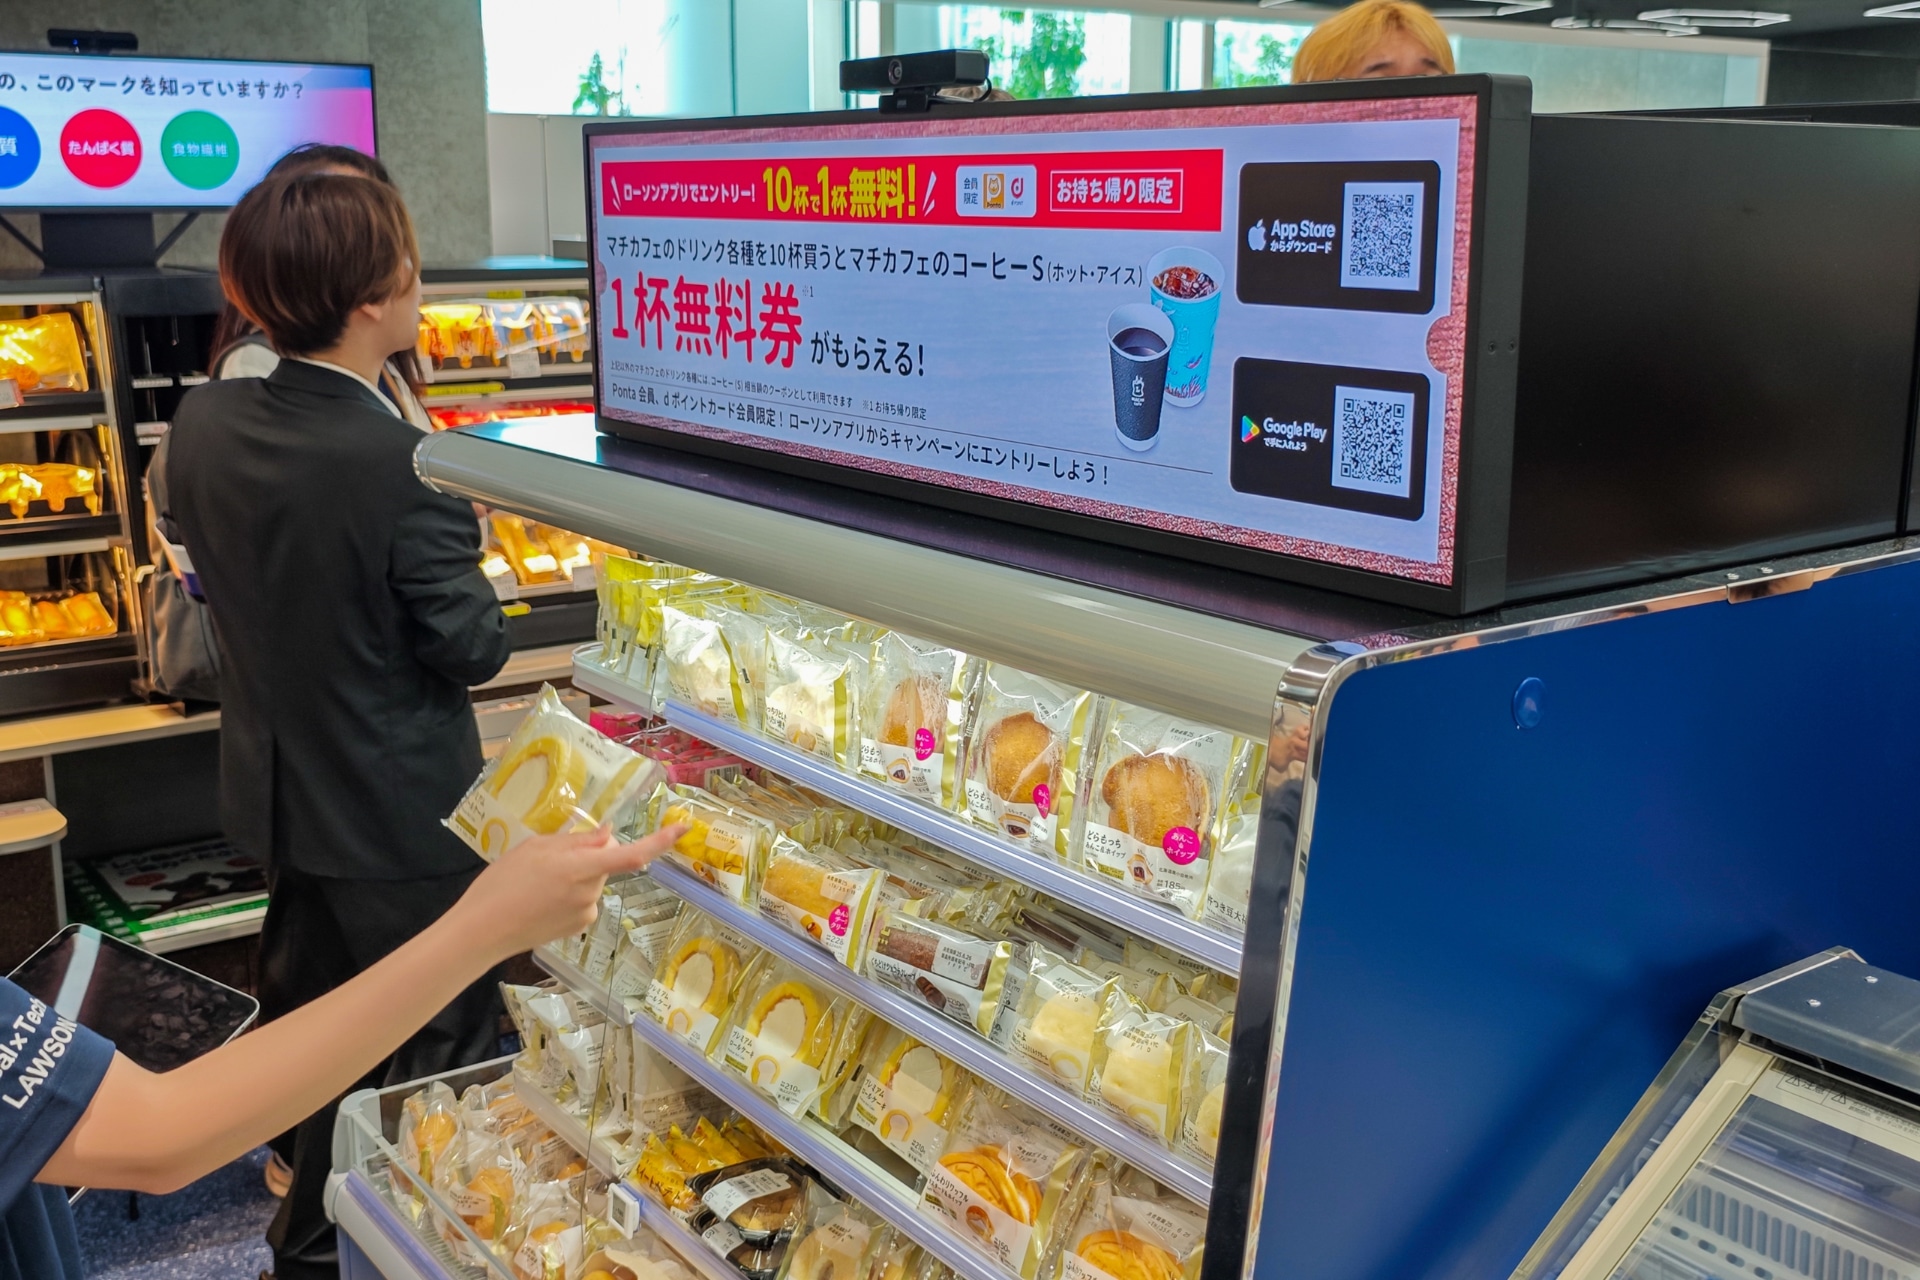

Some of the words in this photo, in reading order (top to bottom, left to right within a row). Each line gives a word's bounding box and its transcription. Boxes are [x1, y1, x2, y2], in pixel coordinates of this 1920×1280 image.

[68, 140, 135, 157] たんぱく質
[172, 142, 228, 158] 食物繊維
[963, 177, 978, 190] 会員
[1056, 176, 1174, 205] お持ち帰り限定
[1270, 219, 1299, 238] App
[1300, 219, 1336, 238] Store
[1269, 241, 1333, 254] からダウンロード
[610, 271, 803, 369] 1杯無料券
[1263, 417, 1302, 440] Google
[1303, 423, 1327, 442] Play
[1263, 437, 1308, 452] で手に入れよう
[1086, 829, 1122, 849] どらもっち
[1170, 832, 1194, 844] あんこ
[1165, 846, 1196, 860] ホイップ
[732, 1030, 753, 1047] プレミアム
[729, 1040, 754, 1059] ロールケーキ
[2, 1016, 78, 1110] LAWSON
[864, 1079, 885, 1098] プレミアム
[861, 1087, 887, 1111] ロールケーキ
